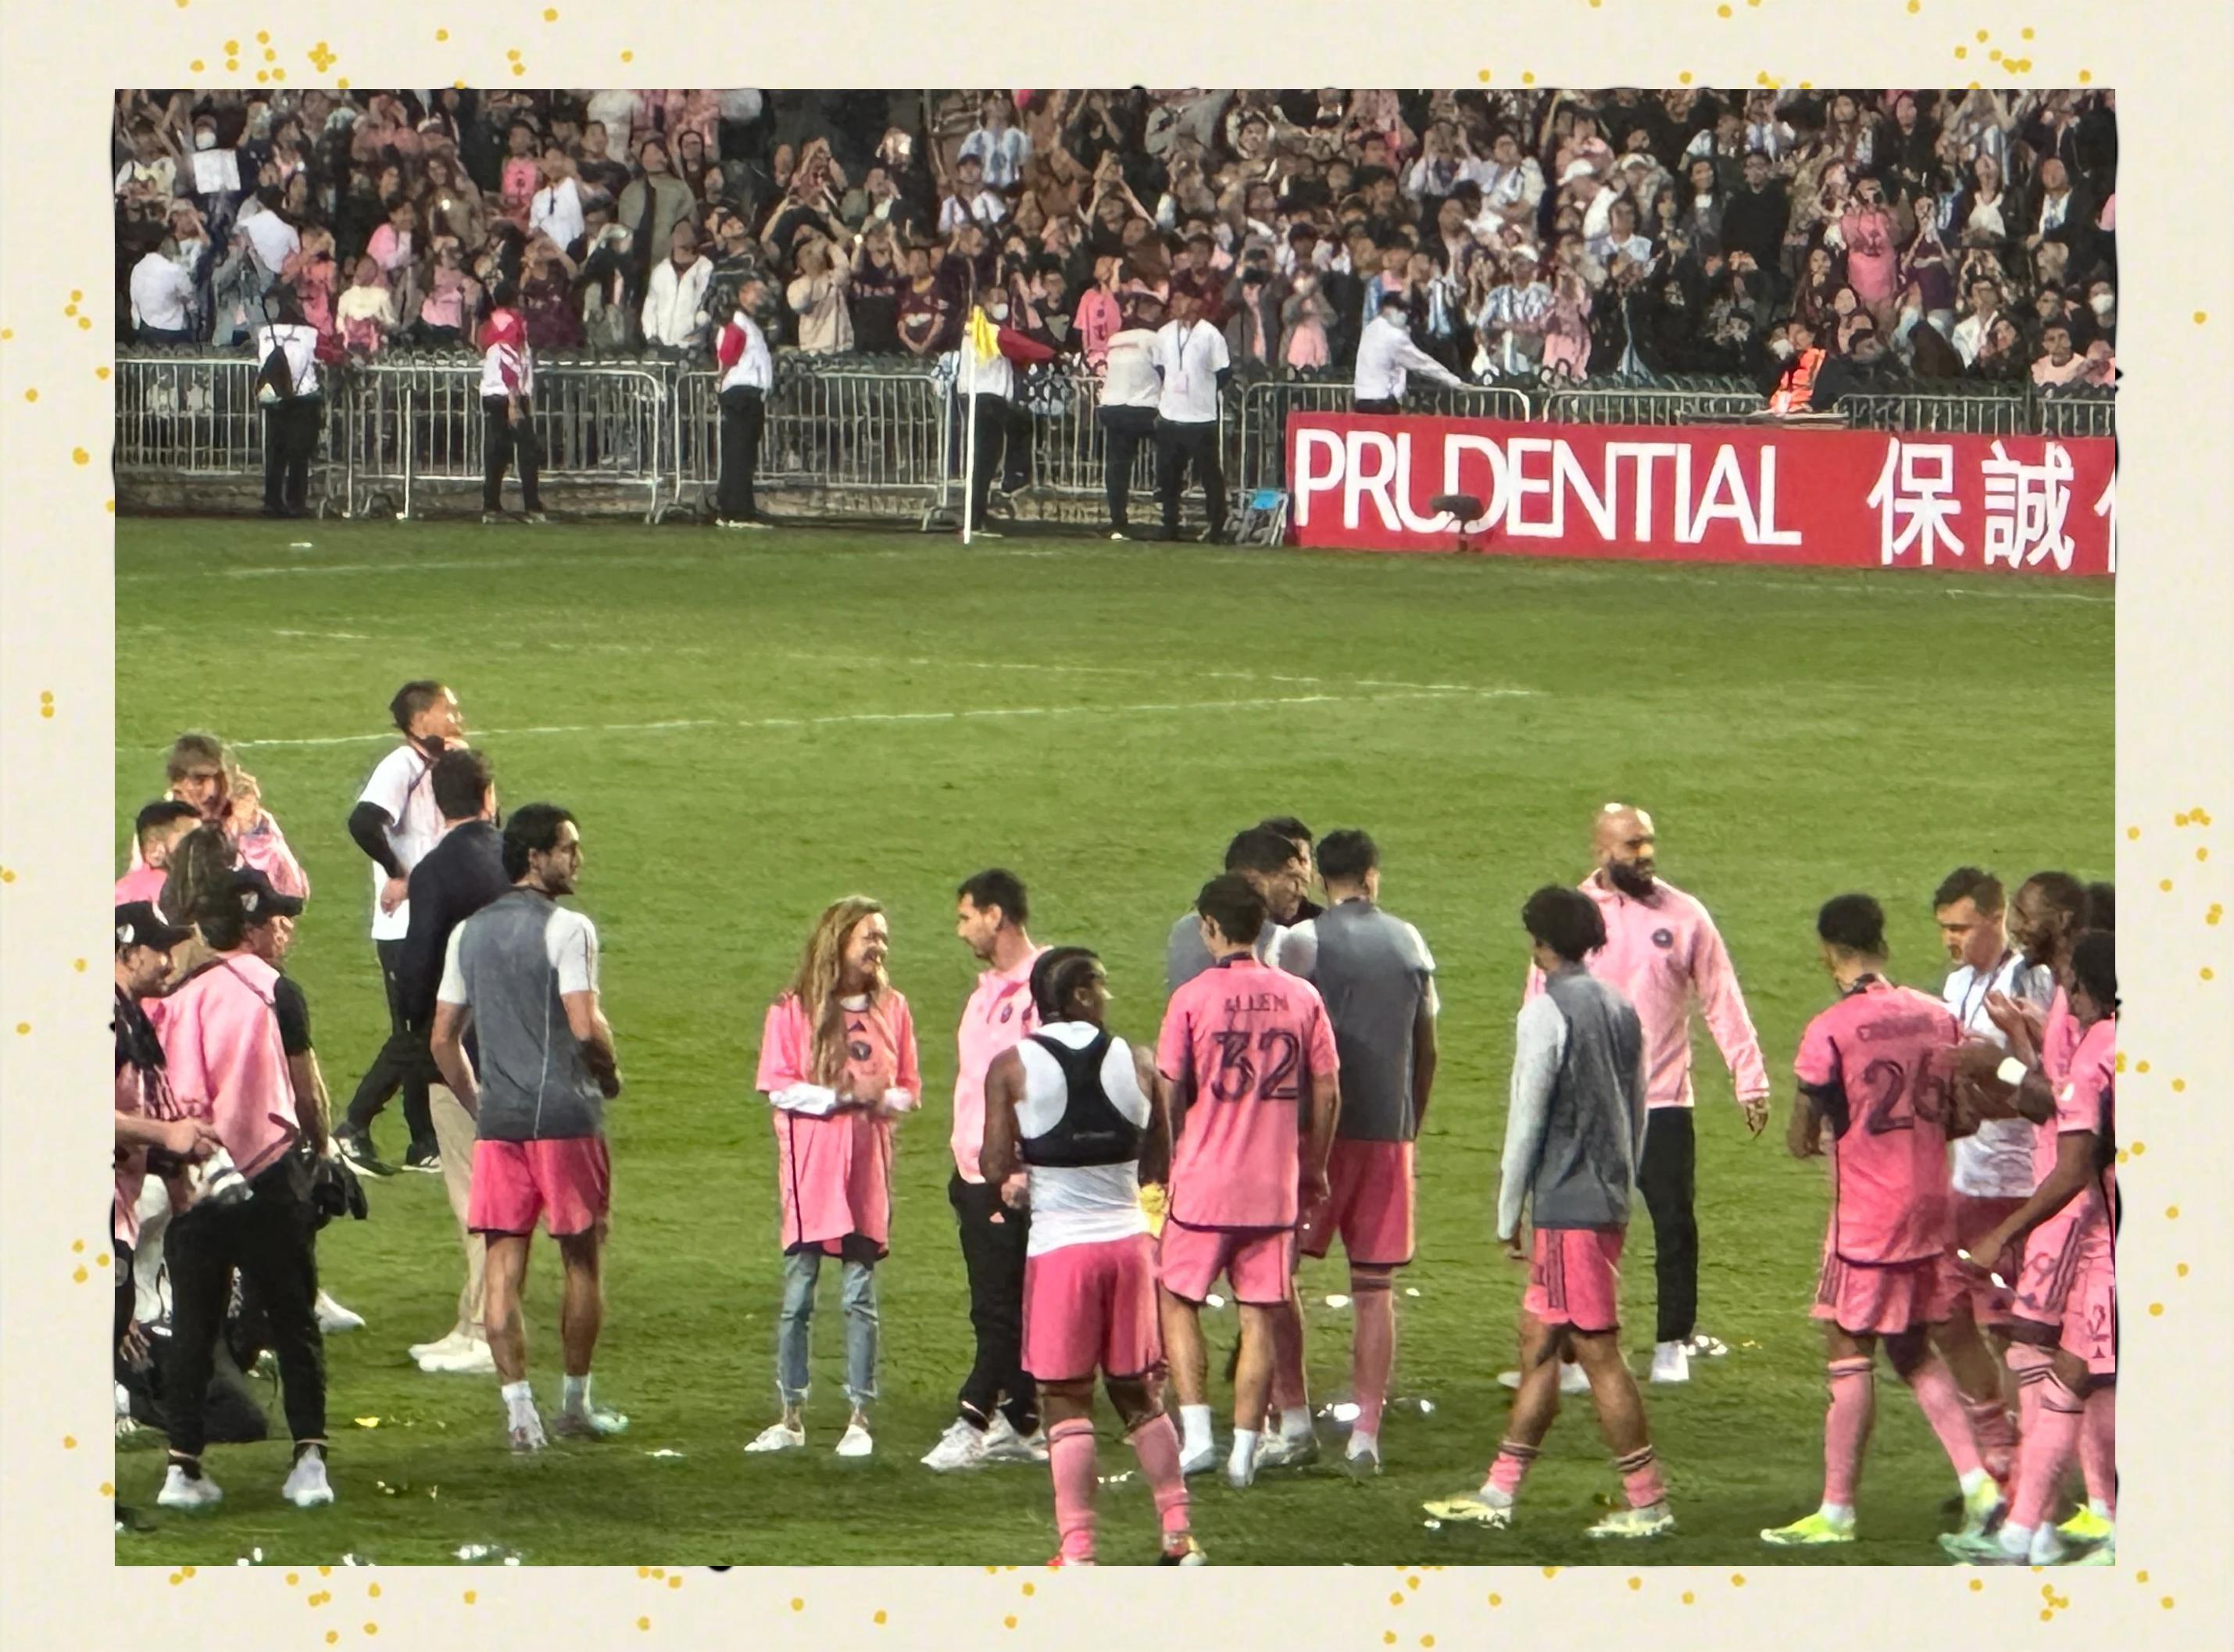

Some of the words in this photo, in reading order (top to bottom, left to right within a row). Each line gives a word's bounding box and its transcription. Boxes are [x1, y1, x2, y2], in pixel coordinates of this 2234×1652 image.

[1294, 428, 1802, 546] PRUDENTIAL
[1212, 1027, 1300, 1101] 32
[1863, 1047, 1946, 1135] 26
